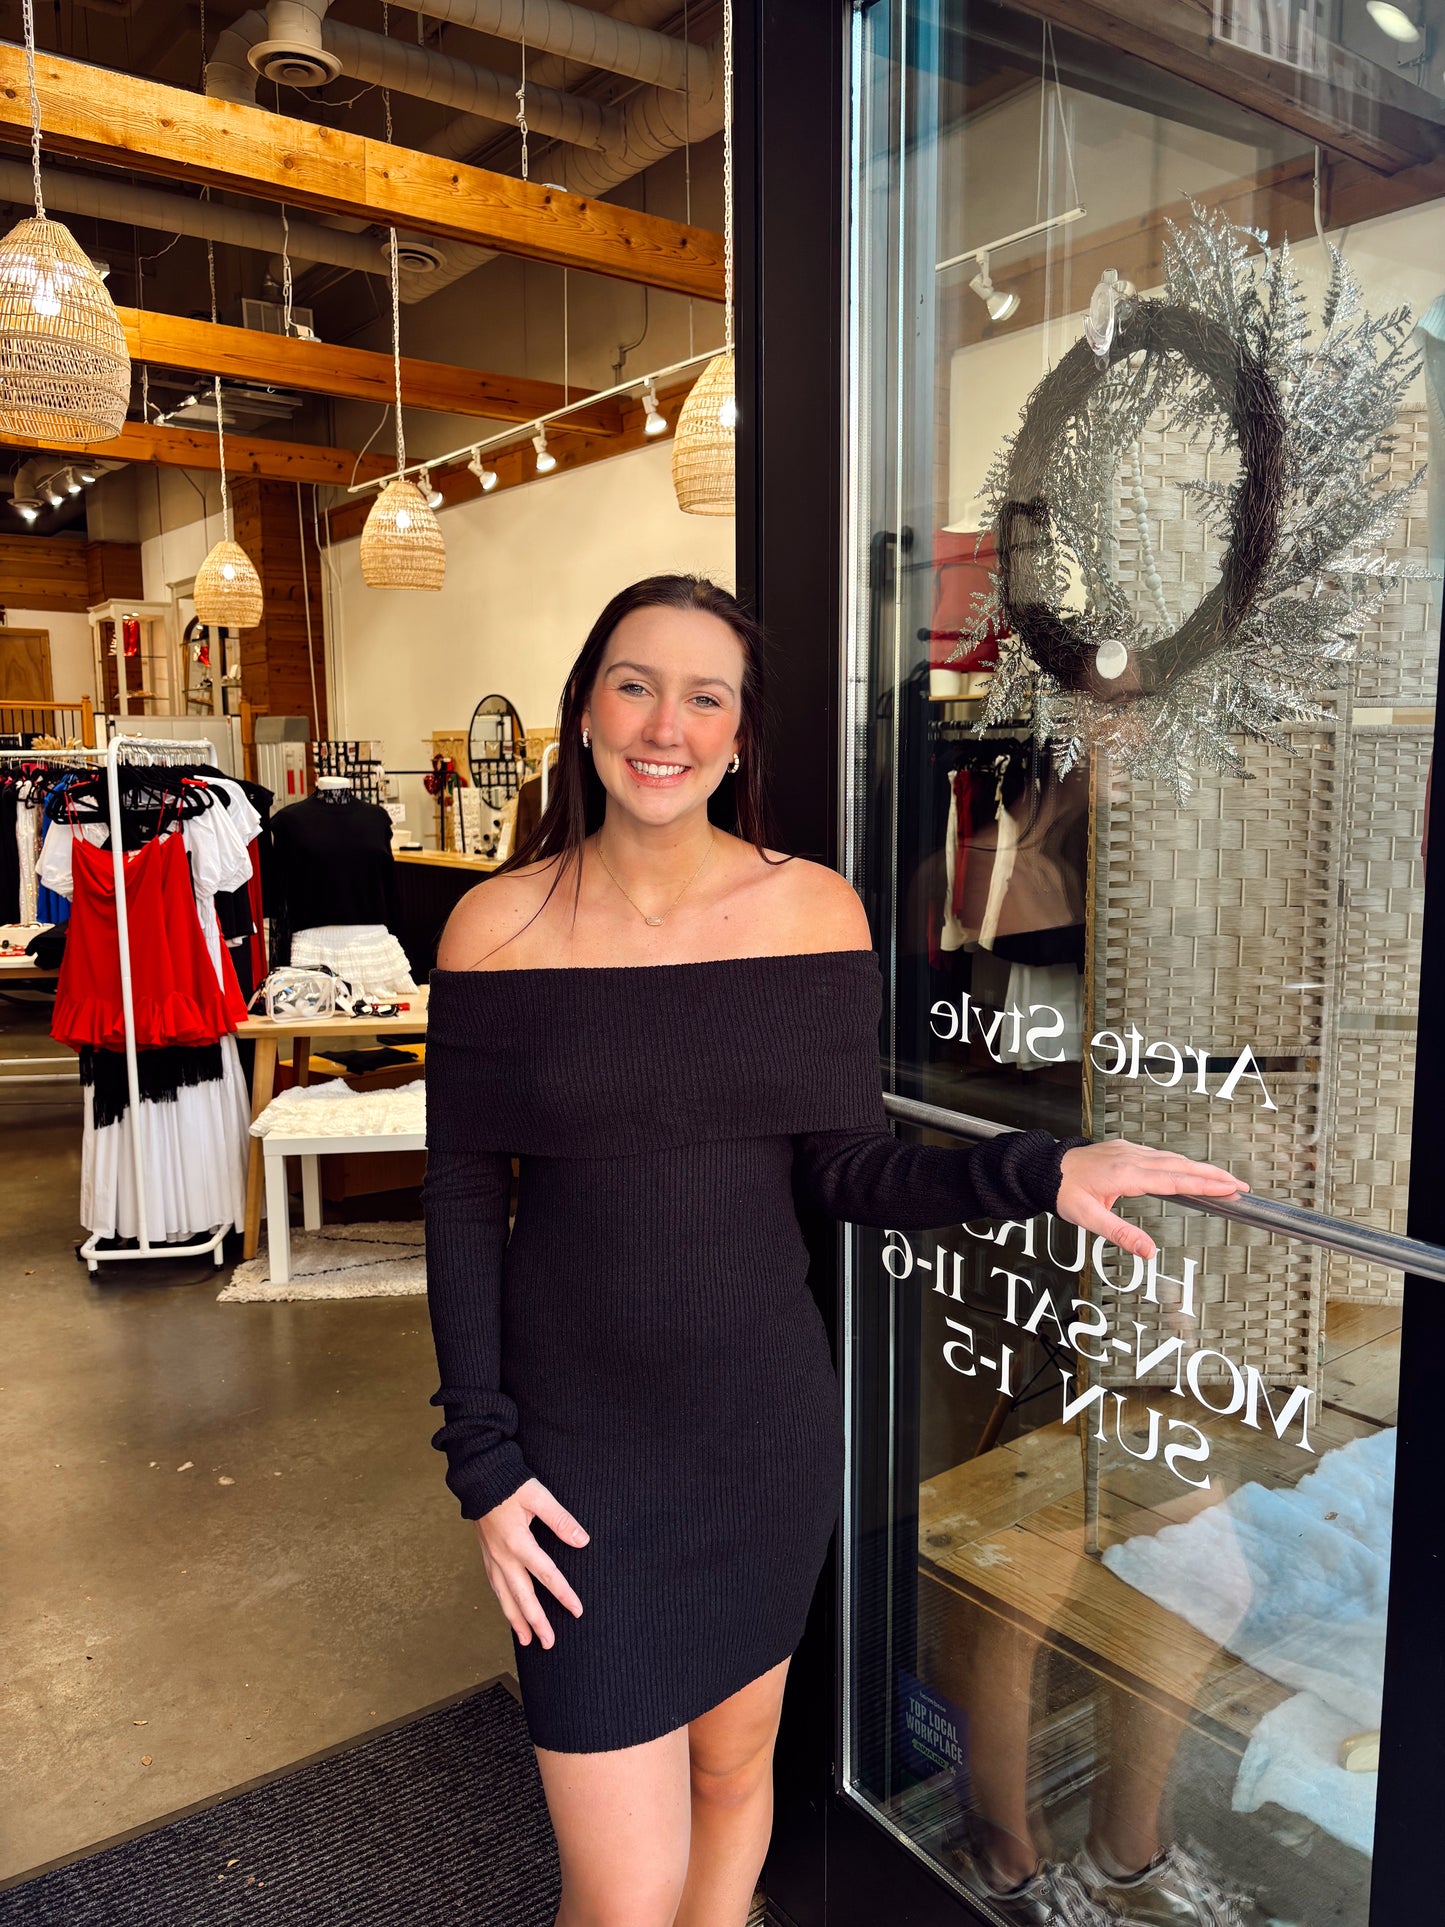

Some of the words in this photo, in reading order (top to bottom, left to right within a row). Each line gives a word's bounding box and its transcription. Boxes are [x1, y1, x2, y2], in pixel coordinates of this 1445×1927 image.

[905, 1711, 964, 1766] WORKPLACE
[909, 1696, 927, 1721] TOP
[928, 1710, 959, 1744] LOCAL
